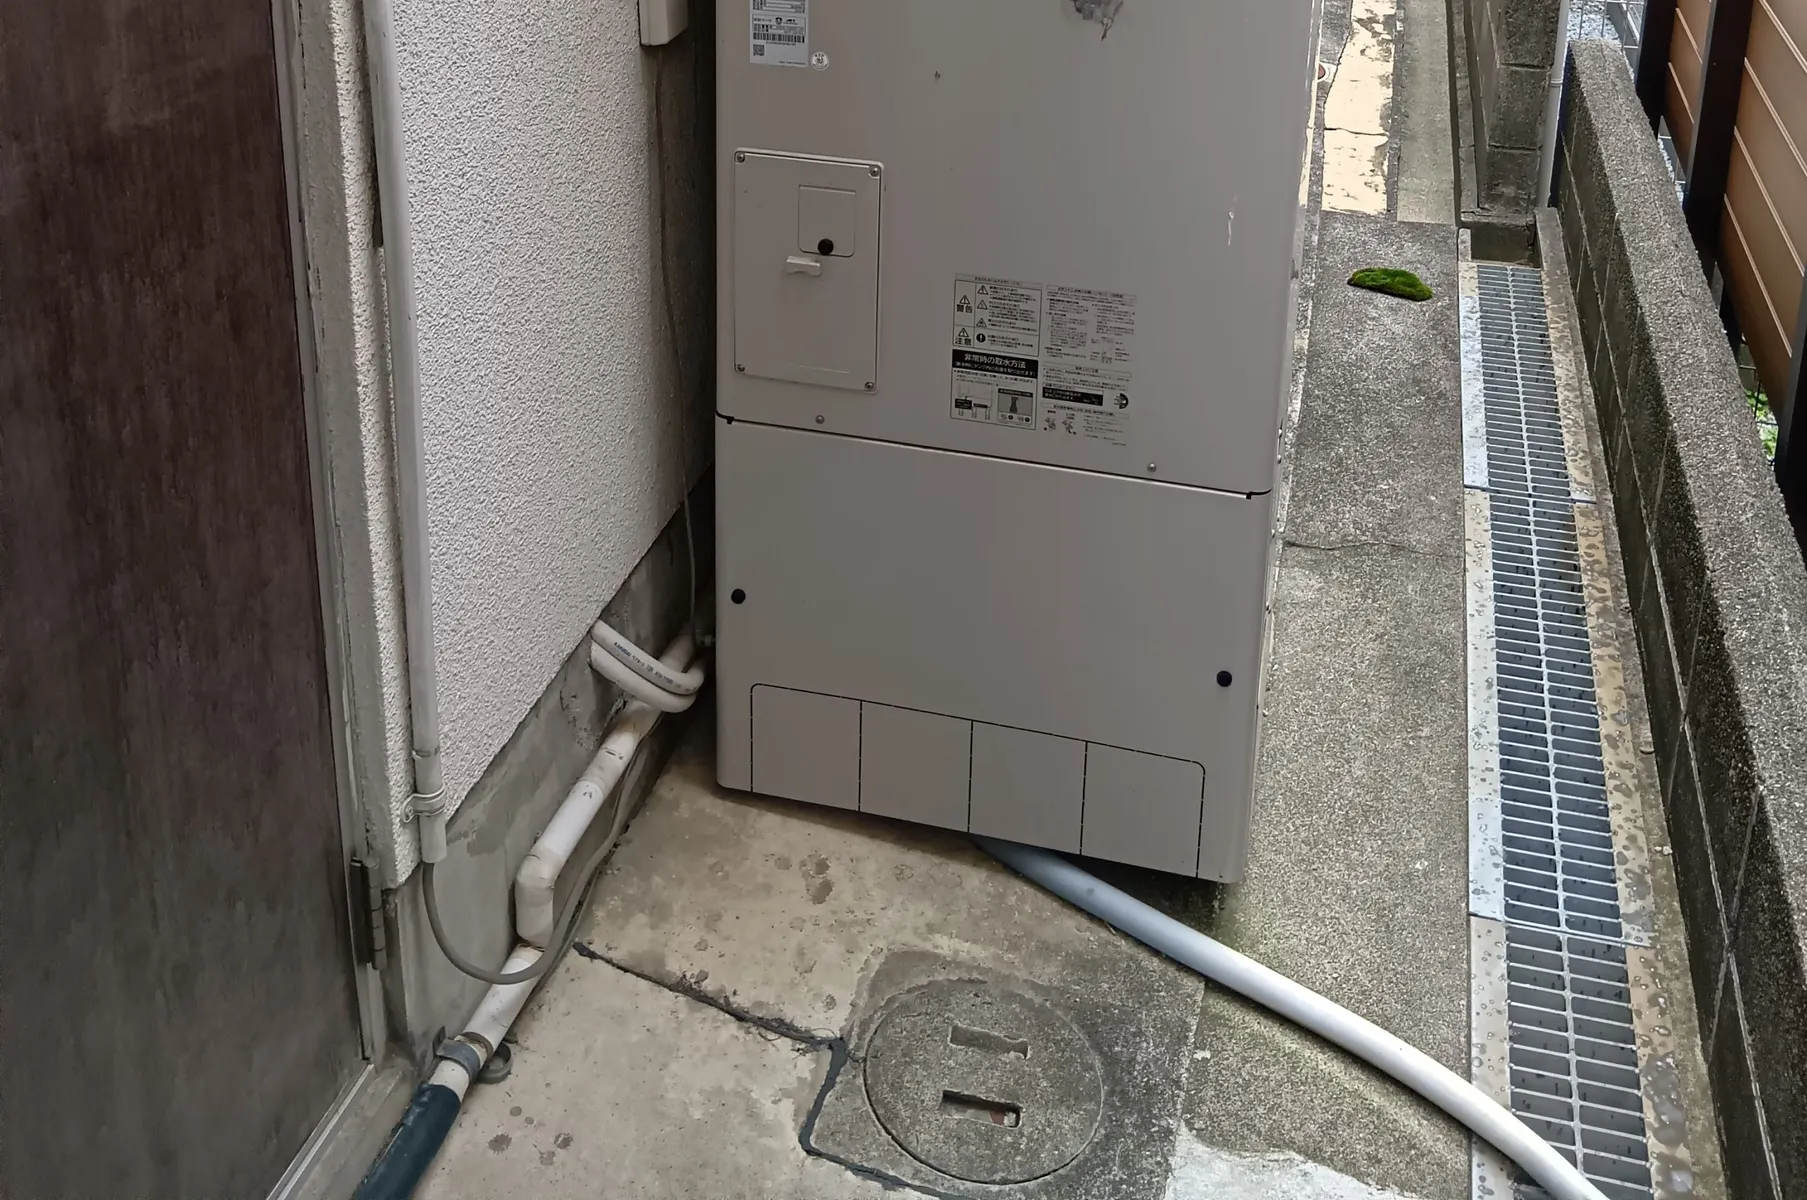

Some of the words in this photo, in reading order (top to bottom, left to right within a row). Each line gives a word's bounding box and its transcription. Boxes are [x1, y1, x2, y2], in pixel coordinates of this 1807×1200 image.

[956, 304, 973, 313] 警告
[954, 336, 972, 346] 注意
[963, 353, 1027, 369] 非常時の取水方法
